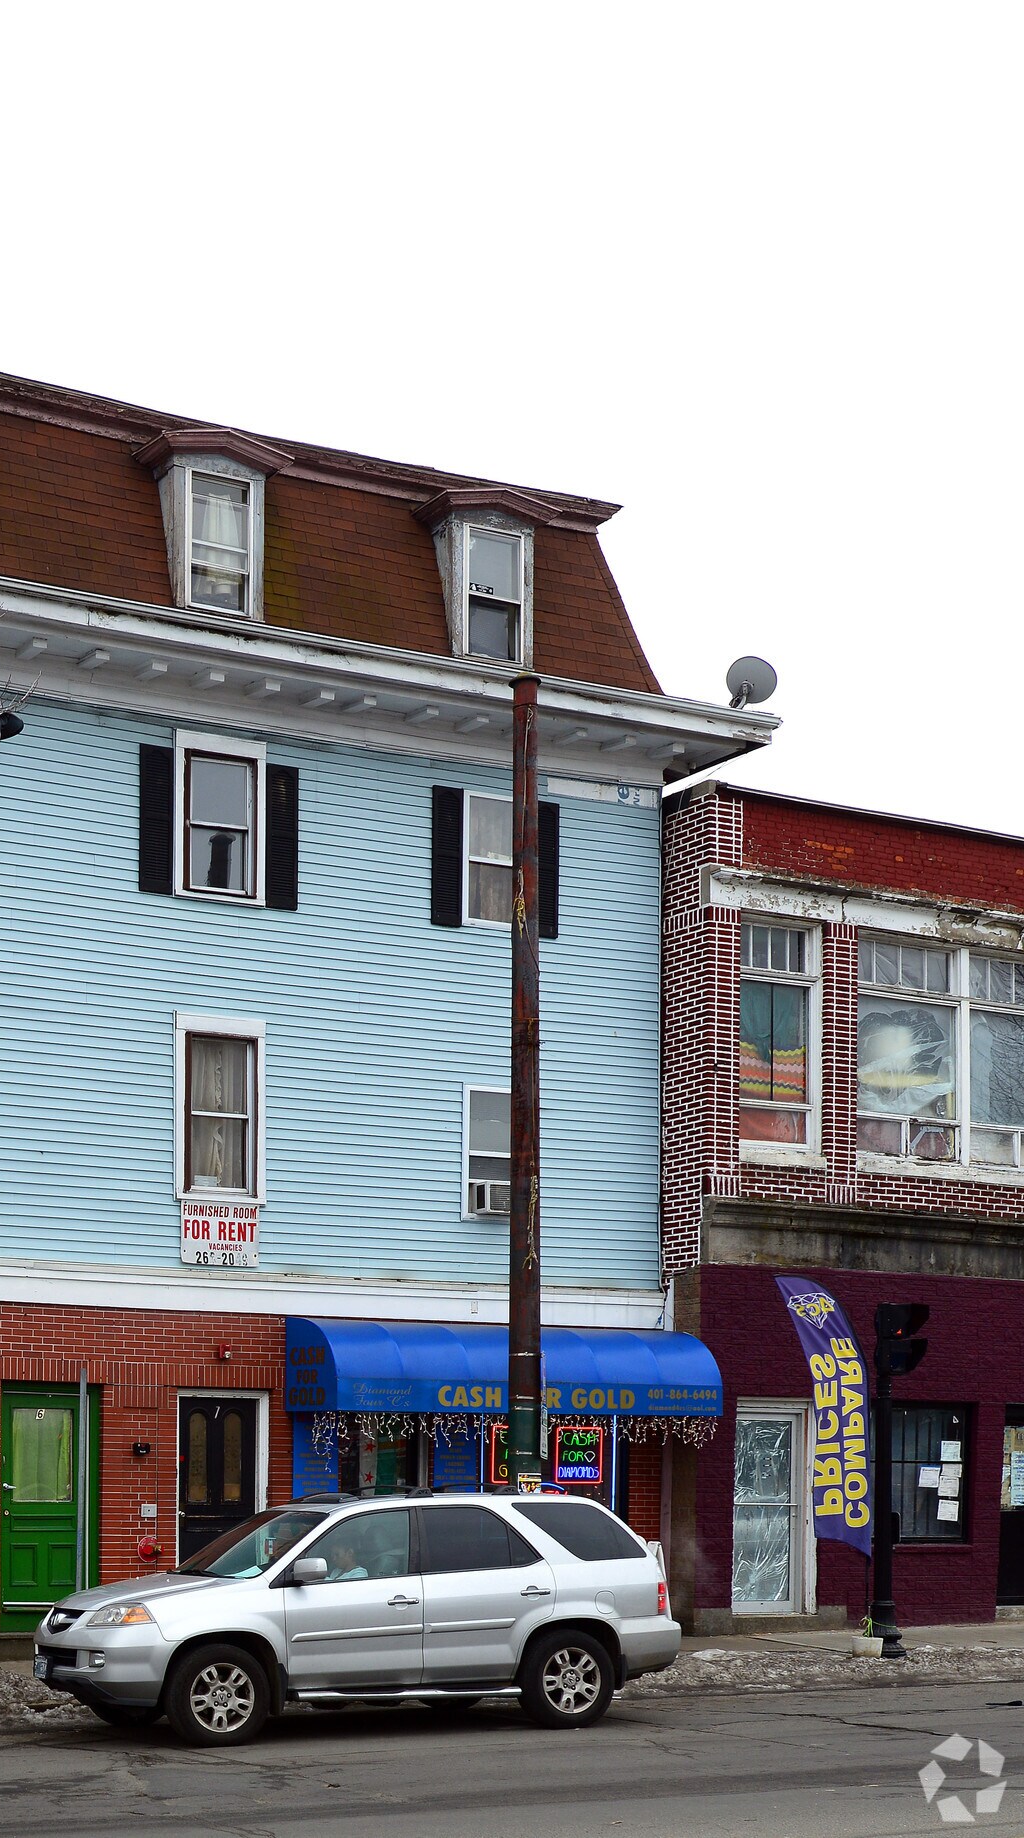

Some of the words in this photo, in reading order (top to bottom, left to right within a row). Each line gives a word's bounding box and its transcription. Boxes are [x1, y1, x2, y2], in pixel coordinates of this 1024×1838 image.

[183, 1204, 230, 1218] FURNISHED
[233, 1207, 257, 1220] ROOM
[184, 1219, 211, 1240] FOR
[218, 1221, 257, 1242] RENT
[208, 1243, 243, 1252] VACANCIES
[289, 1346, 325, 1366] CASH
[296, 1369, 318, 1384] FOR
[353, 1382, 413, 1395] Diamond
[647, 1388, 717, 1400] 401-864-6494
[288, 1387, 326, 1406] GOLD
[437, 1385, 502, 1408] CASH
[571, 1387, 636, 1410] GOLD
[37, 1409, 44, 1419] 6
[563, 1432, 596, 1446] CASH
[562, 1451, 584, 1462] FOR
